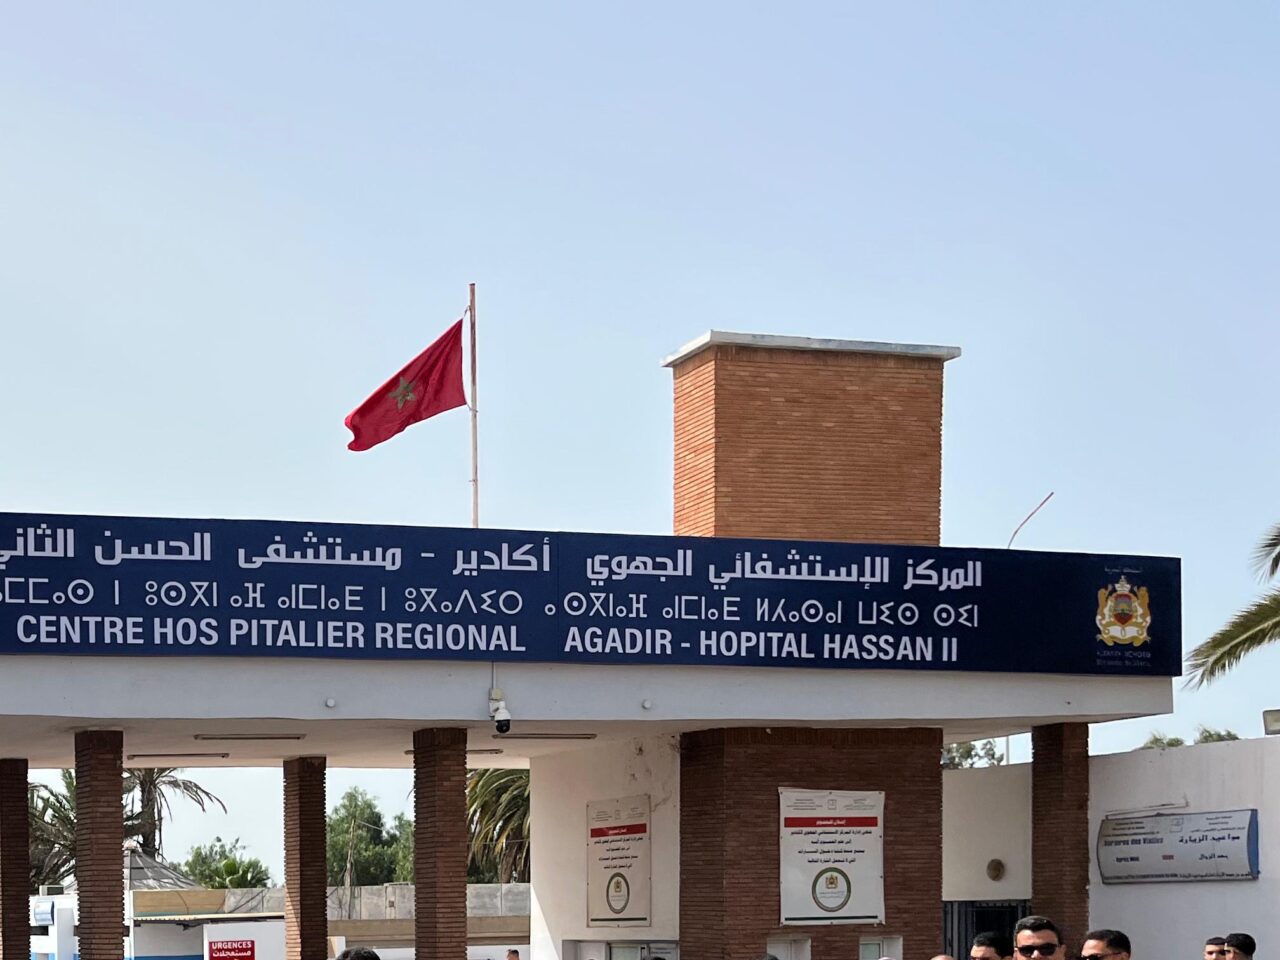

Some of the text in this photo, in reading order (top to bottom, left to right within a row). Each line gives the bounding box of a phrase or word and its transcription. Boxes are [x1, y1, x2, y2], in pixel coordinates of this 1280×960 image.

[94, 530, 212, 566] الحسن
[237, 531, 403, 572] مستشفى
[452, 537, 551, 576] أكادير
[586, 549, 693, 587] الجهوي
[903, 559, 983, 592] المركز
[16, 613, 145, 646] CENTRE
[375, 622, 526, 652] REGIONAL
[564, 626, 673, 655] AGADIR
[699, 630, 819, 659] HOPITAL
[823, 633, 934, 662] HASSAN
[942, 636, 958, 662] II
[211, 941, 252, 950] URGENCES
[212, 949, 252, 958] مستعجلات
